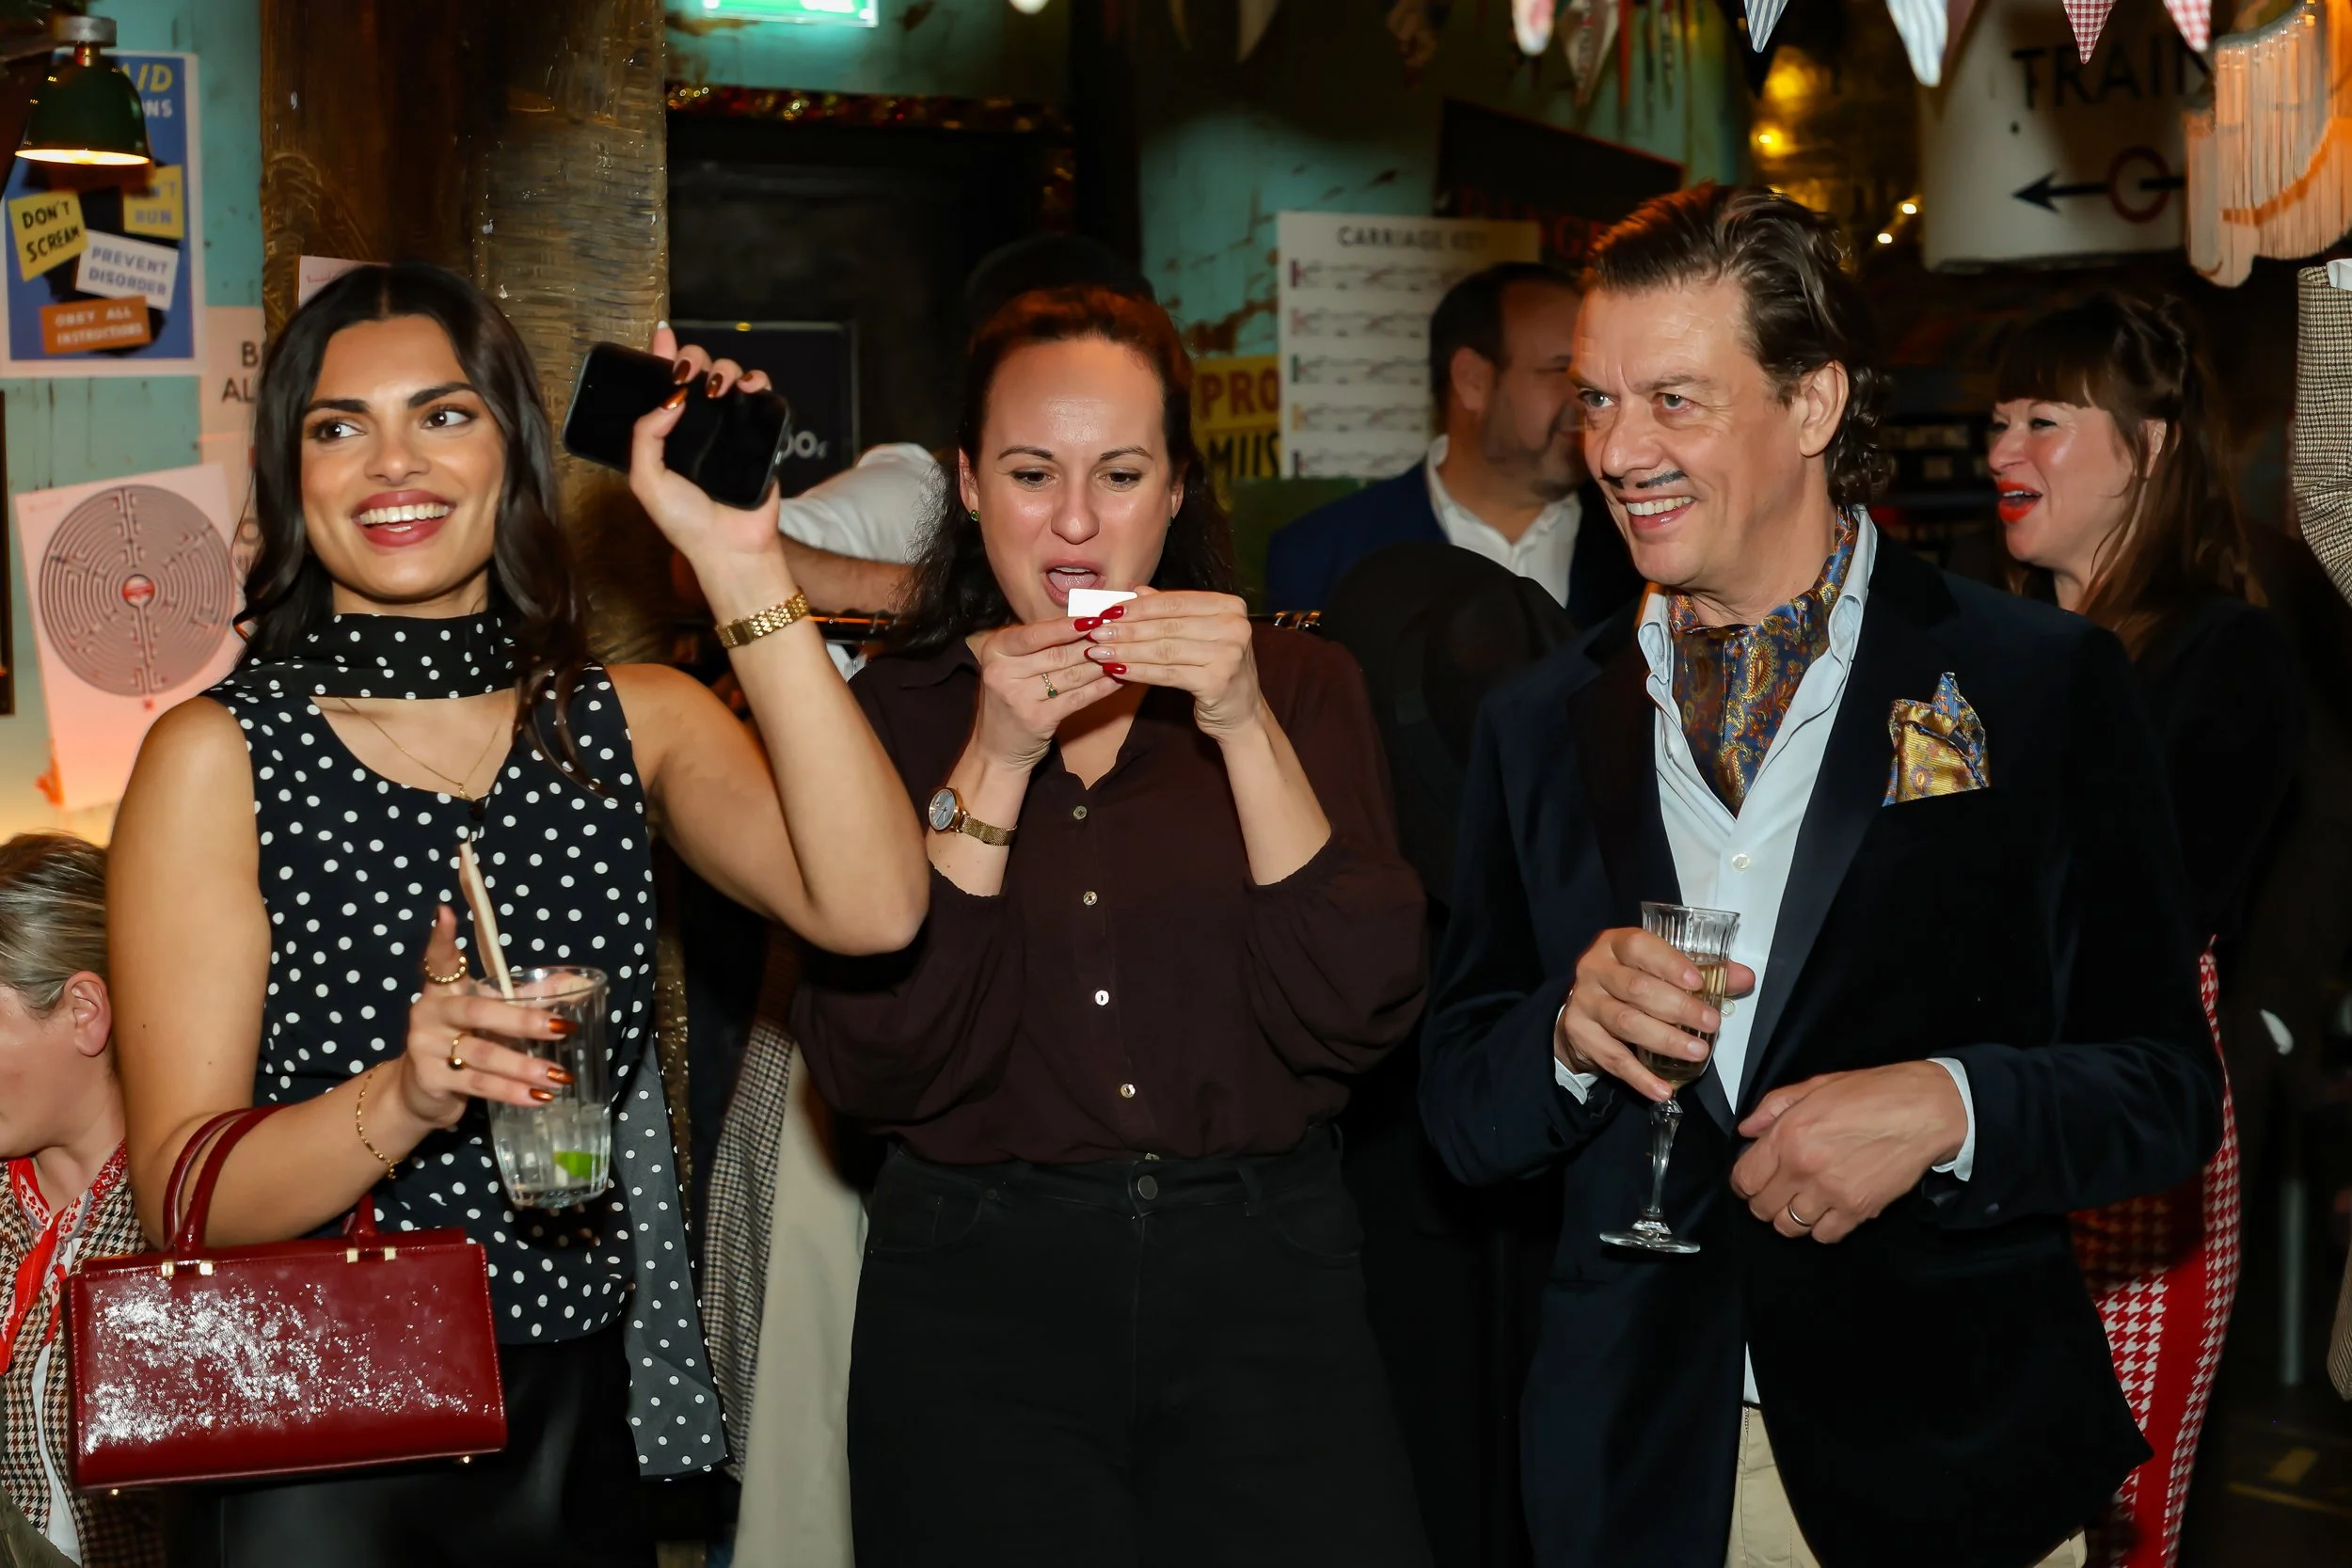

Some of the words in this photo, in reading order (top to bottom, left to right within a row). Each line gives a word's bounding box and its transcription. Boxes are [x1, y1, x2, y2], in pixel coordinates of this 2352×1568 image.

[22, 199, 70, 230] DON'T
[26, 226, 80, 263] SCREAM
[91, 245, 169, 275] PREVENT
[88, 266, 167, 296] DISORDER
[105, 305, 133, 321] ALL
